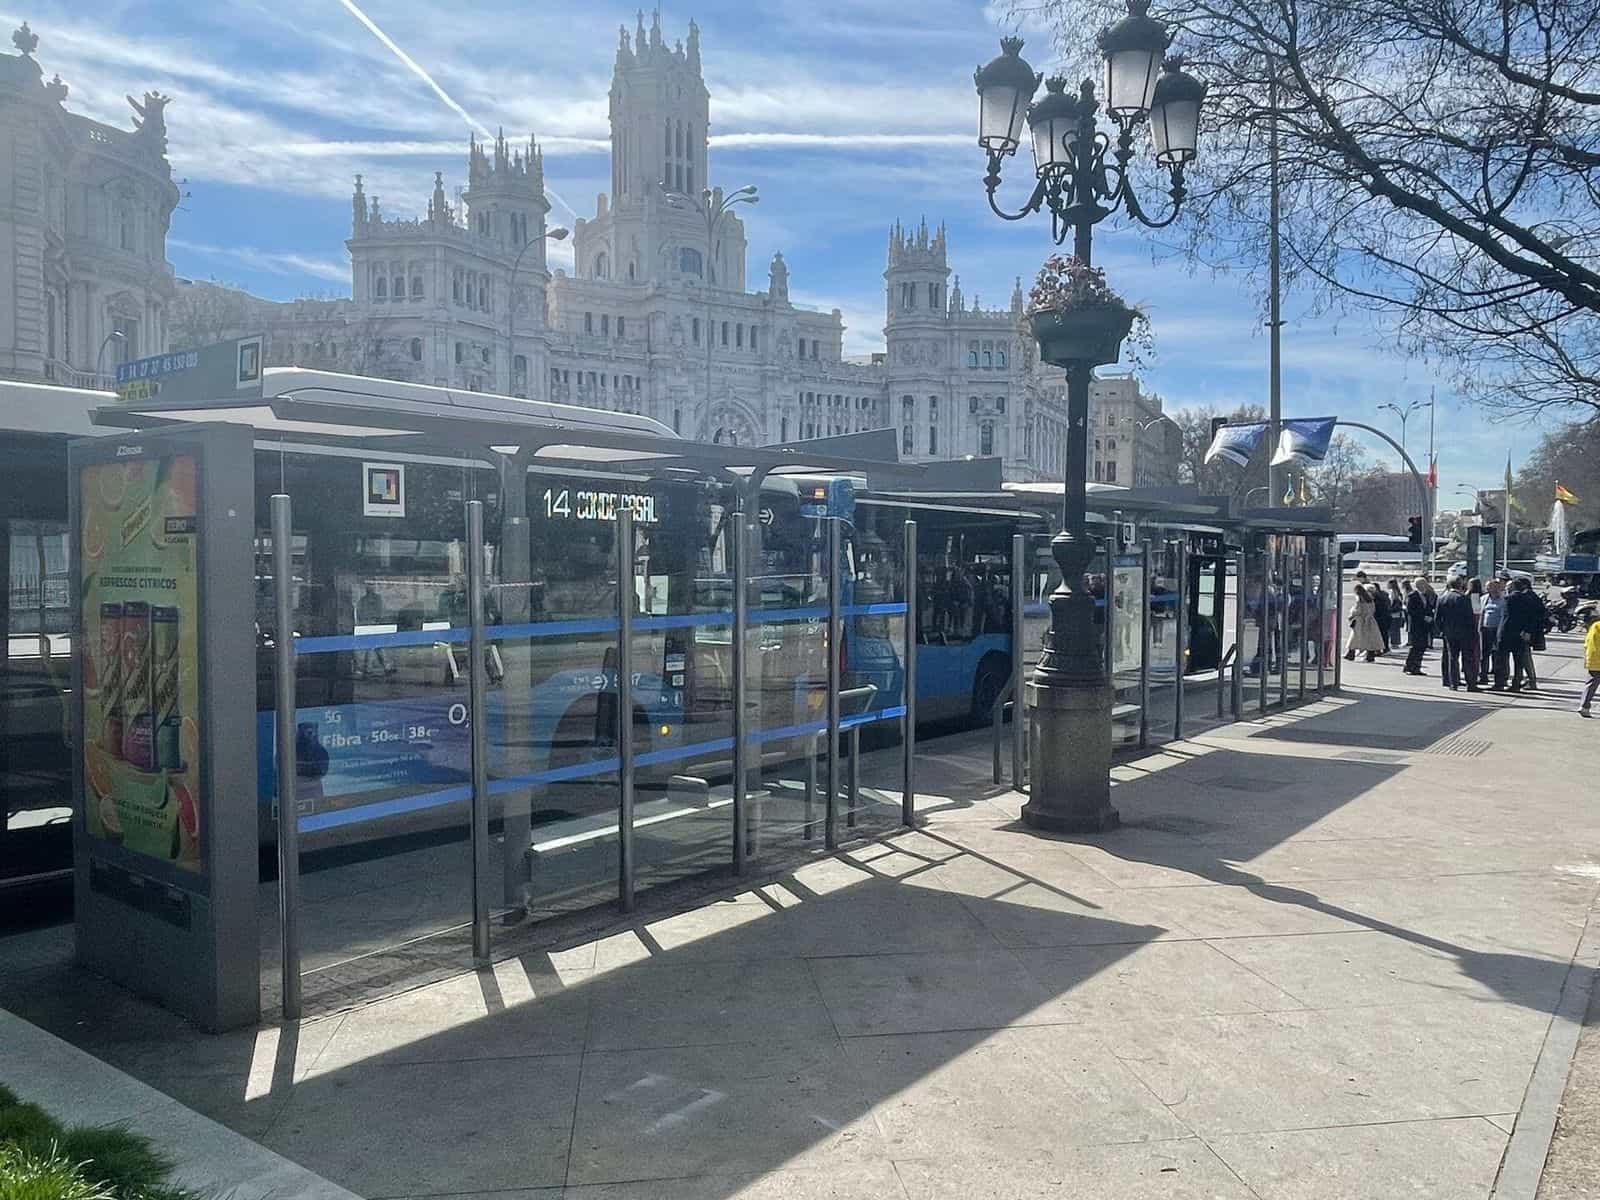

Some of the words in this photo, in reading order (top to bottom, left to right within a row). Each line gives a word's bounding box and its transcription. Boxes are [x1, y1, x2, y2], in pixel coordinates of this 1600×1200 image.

[543, 488, 572, 518] 14
[576, 491, 618, 521] CONDE
[324, 710, 343, 725] 5G
[321, 733, 362, 747] Fibra
